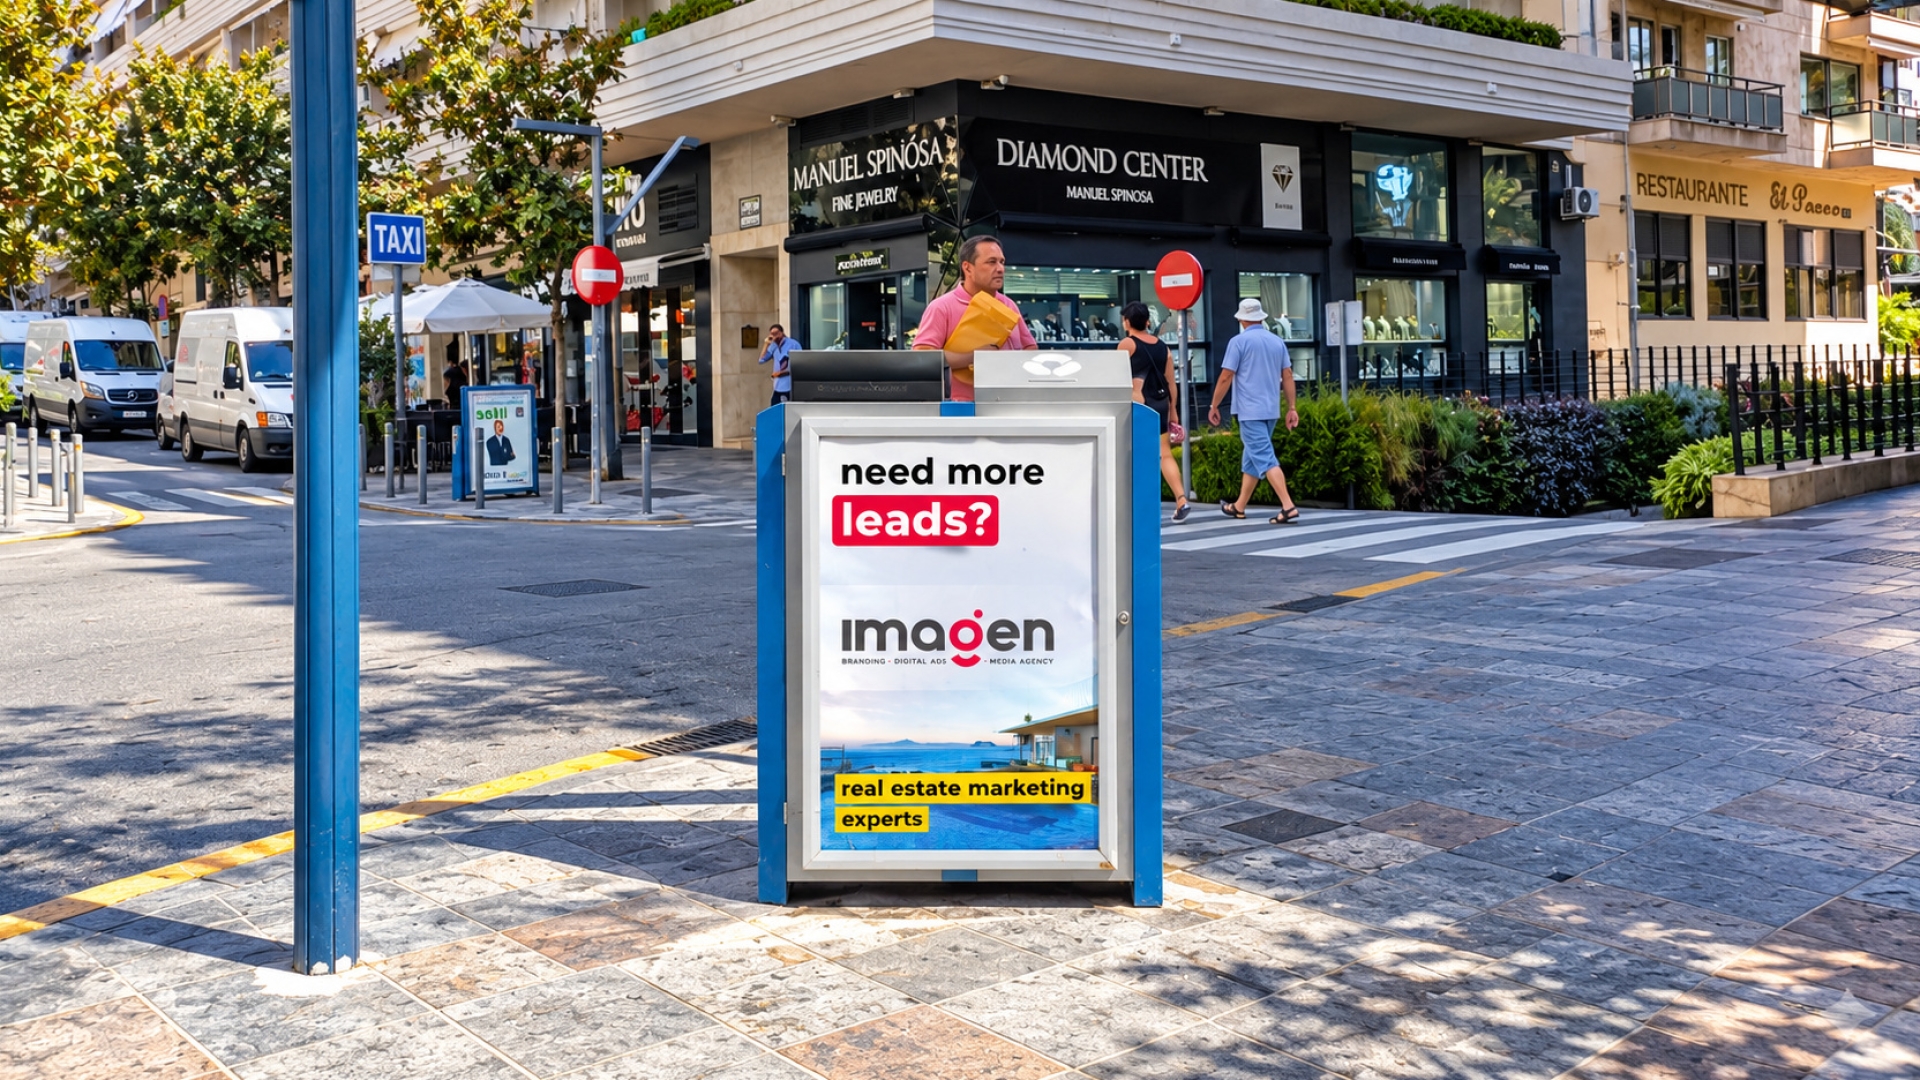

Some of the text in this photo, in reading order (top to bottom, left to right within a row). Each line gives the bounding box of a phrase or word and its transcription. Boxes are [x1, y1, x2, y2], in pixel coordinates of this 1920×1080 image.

[793, 154, 864, 192] MANUEL
[996, 138, 1209, 182] DIAMOND CENTER
[832, 186, 899, 213] FINE JEWELRY
[1066, 185, 1154, 204] MANUEL SPINOSA
[1636, 172, 1749, 207] RESTAURANTE
[1769, 181, 1789, 211] El
[374, 223, 422, 256] TAXI
[841, 457, 1044, 485] need more
[842, 501, 993, 537] leads?
[841, 609, 1055, 668] imagen
[842, 778, 1085, 801] real estate marketing
[842, 811, 923, 831] experts
